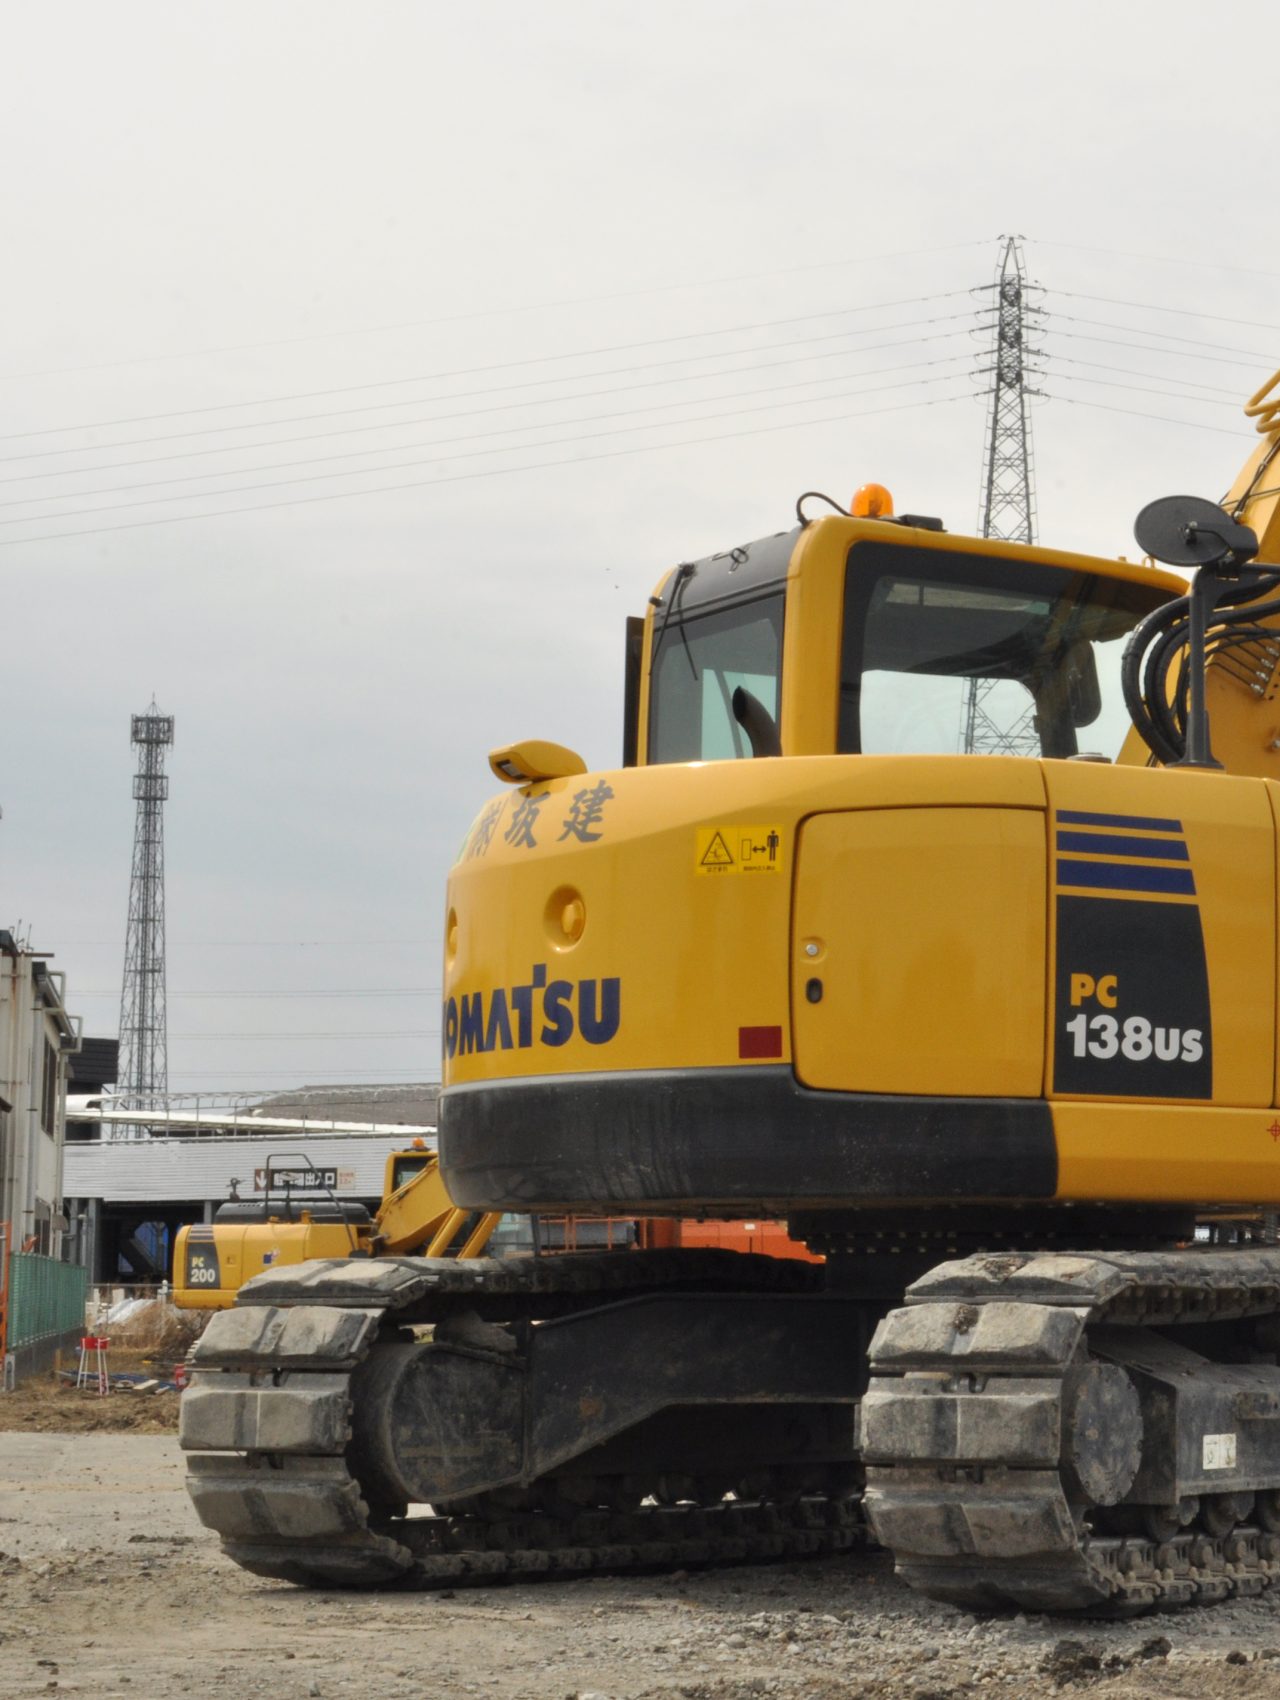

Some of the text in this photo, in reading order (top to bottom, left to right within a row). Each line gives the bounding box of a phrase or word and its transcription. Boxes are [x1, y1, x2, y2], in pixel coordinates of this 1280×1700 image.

[1070, 973, 1118, 1009] PC
[442, 963, 621, 1061] OMATSU
[191, 1256, 205, 1268] PC
[190, 1268, 216, 1283] 200
